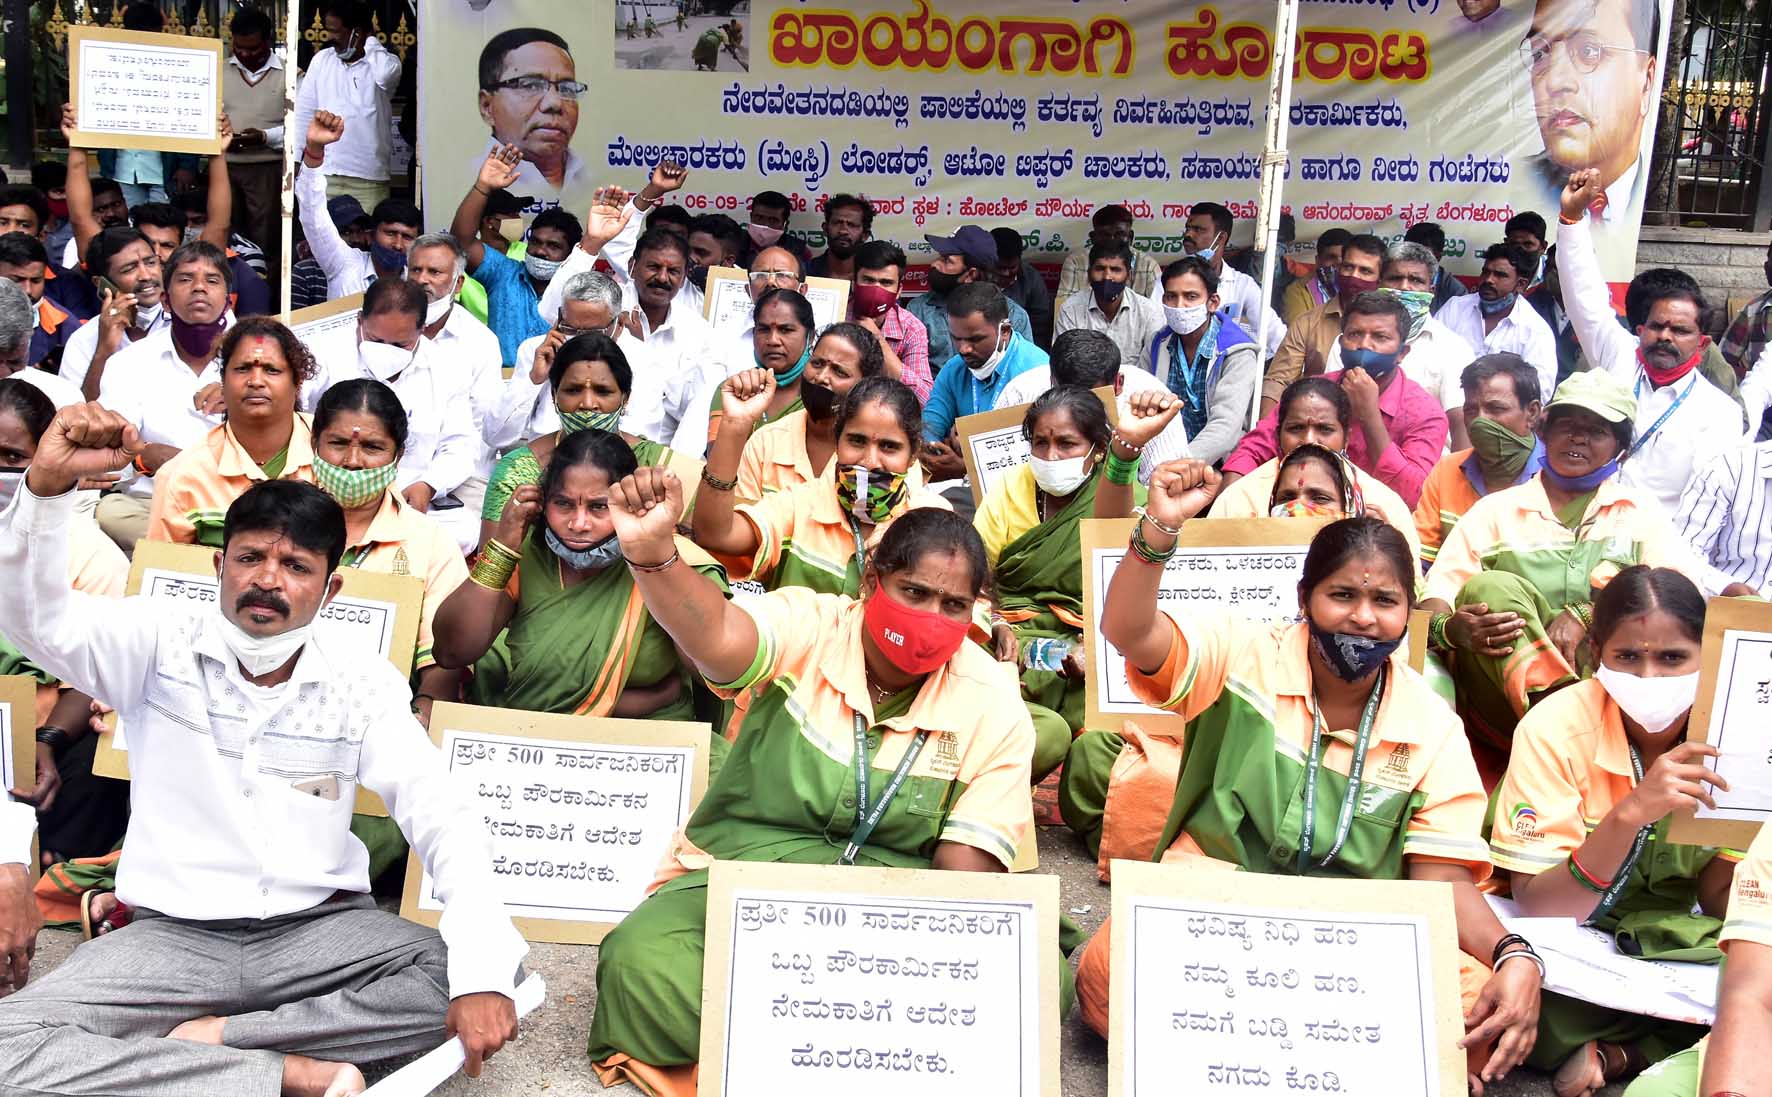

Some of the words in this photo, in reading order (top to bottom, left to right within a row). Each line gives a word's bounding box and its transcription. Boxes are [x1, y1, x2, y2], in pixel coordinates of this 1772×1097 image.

[770, 0, 1136, 76] ಖಾಯಂಗಾಗಿ
[723, 82, 910, 129] ನೇರವೇತನದಡಿಯಲ್ಲಿ
[920, 89, 1026, 131] ಪಾಲಿಕೆಯಲ್ಲಿ
[1037, 90, 1103, 138] ಕರ್ತವ್ಯ
[1113, 94, 1255, 136] ನಿರ್ವಹಿಸುತ್ತಿರುವ,
[1264, 97, 1407, 130] ರಕಾರ್ಮಿಕರು,
[758, 139, 830, 191] (ಮೇಸ್ತ್ರಿ)
[944, 147, 1006, 178] ಆಟೋ
[1016, 148, 1073, 189] ಟಿಪ್ಪರ್
[1084, 152, 1170, 182] ಚಾಲಕರು,
[1301, 152, 1361, 182] ಹಾಗೂ
[1371, 153, 1420, 183] ನೀರು
[1429, 154, 1511, 184] ಗಂಟೆಗರು
[911, 197, 940, 226] ಸ್ಥಳ
[959, 197, 1028, 218] ಹೋಟೆಲ್
[1035, 198, 1094, 219] ಮೌರ್ಯ
[1303, 202, 1393, 221] ಆನಂದರಾವ್
[1436, 202, 1516, 223] ಬೆಂಗಳೂರು
[1225, 555, 1297, 571] ಒಳಚರಂಡಿ
[884, 627, 904, 647] PLAYER
[456, 742, 497, 766] ಪ್ರತೀ
[507, 747, 544, 766] 500
[555, 752, 679, 774] ಸಾರ್ವಜನಿಕರಿಗೆ
[478, 782, 513, 810] ಒಬ್ಬ
[523, 783, 649, 809] ಪೌರಕಾರ್ಮಿಕನ
[585, 826, 643, 846] ಆದೇಶ
[493, 856, 620, 884] ಹೊರಡಿಸಬೇಕು.
[741, 903, 789, 931] ಪ್ರತೀ
[803, 906, 847, 928] 500
[862, 911, 1013, 936] ಸಾರ್ವಜನಿಕರಿಗೆ
[1187, 916, 1254, 951] ಭವಿಷ್ಯ
[1265, 920, 1300, 946] ನಿಧಿ
[1314, 925, 1359, 946] ಹಣ
[772, 952, 815, 984] ಒಬ್ಬ
[827, 951, 979, 981] ಪೌರಕಾರ್ಮಿಕನ
[1184, 961, 1236, 999] ನಮ್ಮ
[1246, 965, 1300, 990] ಕೂಲಿ
[1314, 972, 1365, 995] ಹಣ.
[772, 994, 893, 1023] ನೇಮಕಾತಿಗೆ
[906, 1003, 977, 1026] ಆದೇಶ
[1172, 1009, 1236, 1034] ನಮಗೆ
[1248, 1016, 1294, 1050] ಬಡ್ಡಿ
[1304, 1018, 1382, 1044] ಸಮೇತ
[791, 1043, 955, 1075] ಹೊರಡಿಸಬೇಕು.
[1207, 1064, 1272, 1088] ನಗದು
[1286, 1066, 1348, 1093] ಕೊಡಿ.
